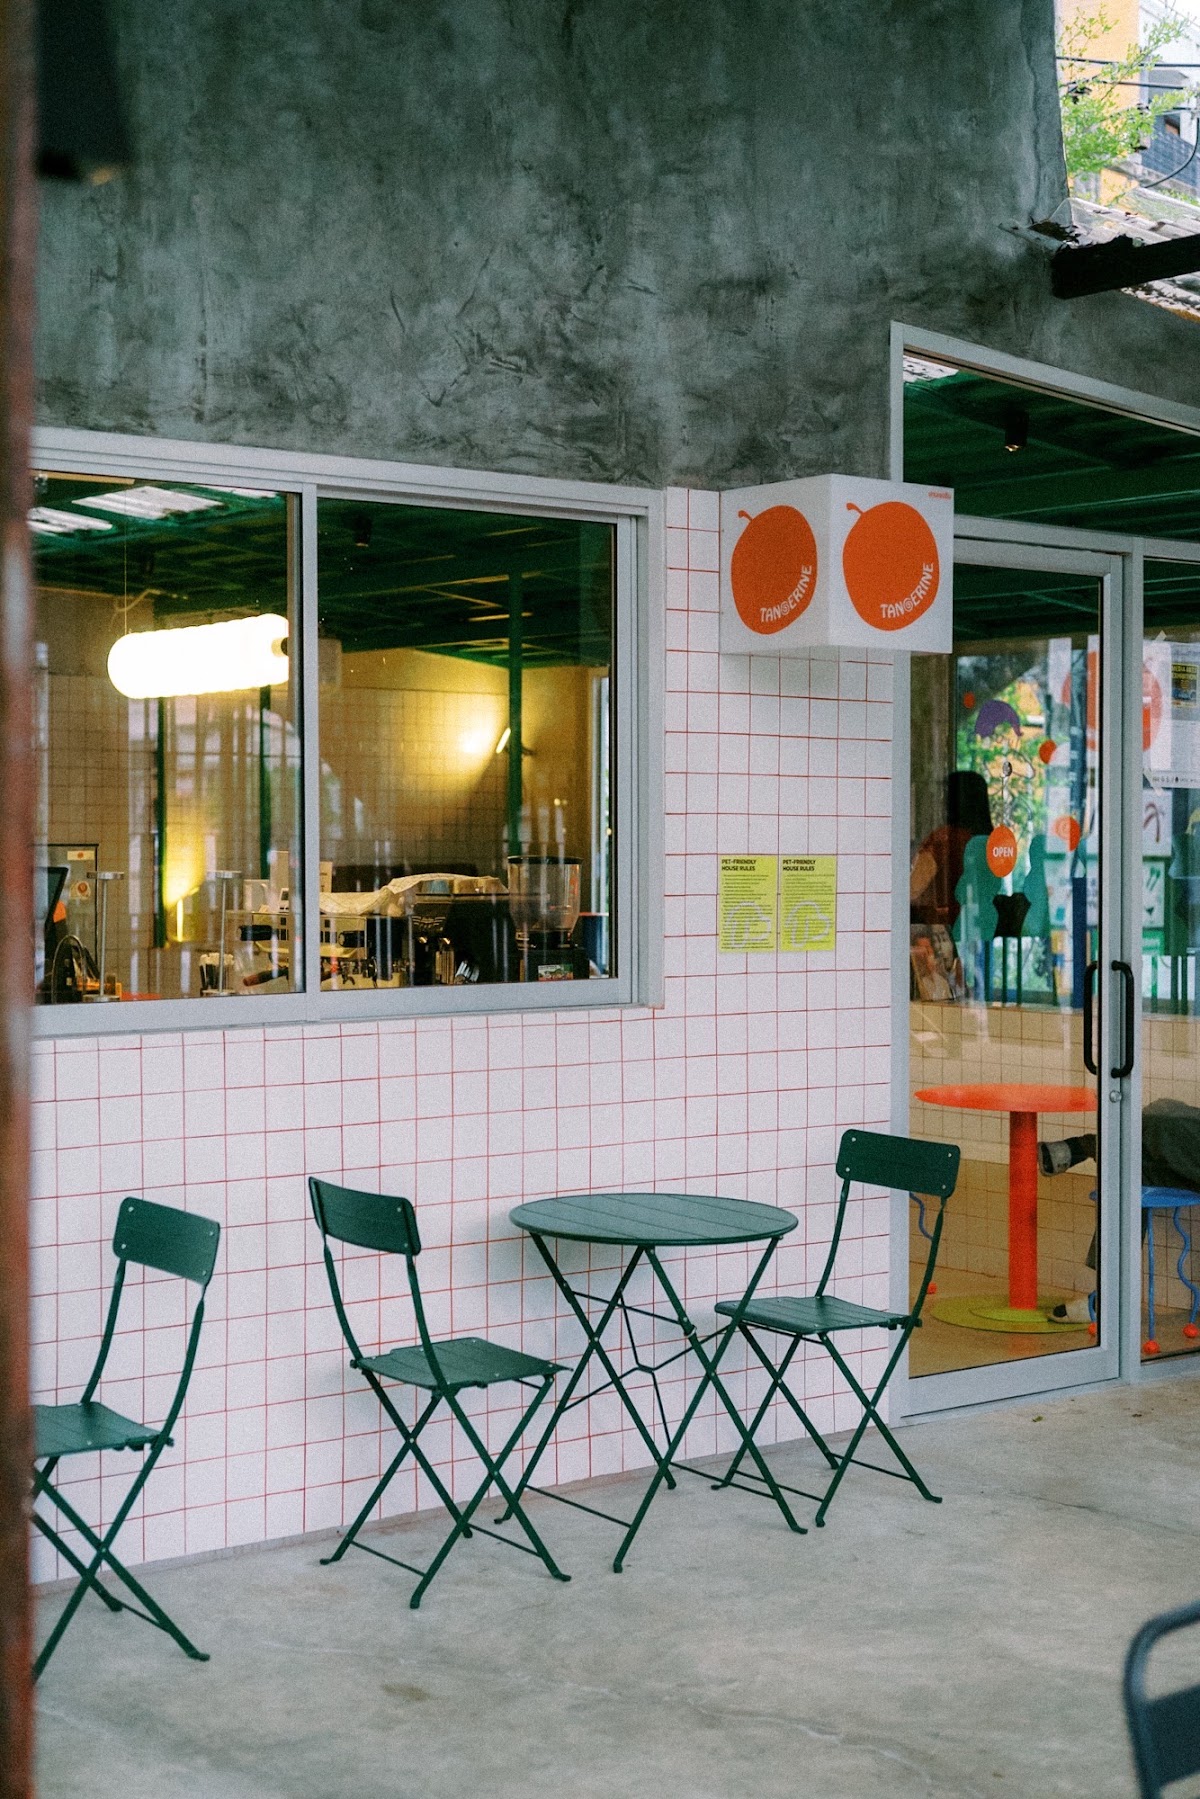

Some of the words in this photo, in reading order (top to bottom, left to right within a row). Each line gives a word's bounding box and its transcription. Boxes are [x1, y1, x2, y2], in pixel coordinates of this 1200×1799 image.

[760, 564, 813, 623] TANGERINE
[880, 562, 934, 618] TANGERINE
[993, 847, 1013, 857] OPEN
